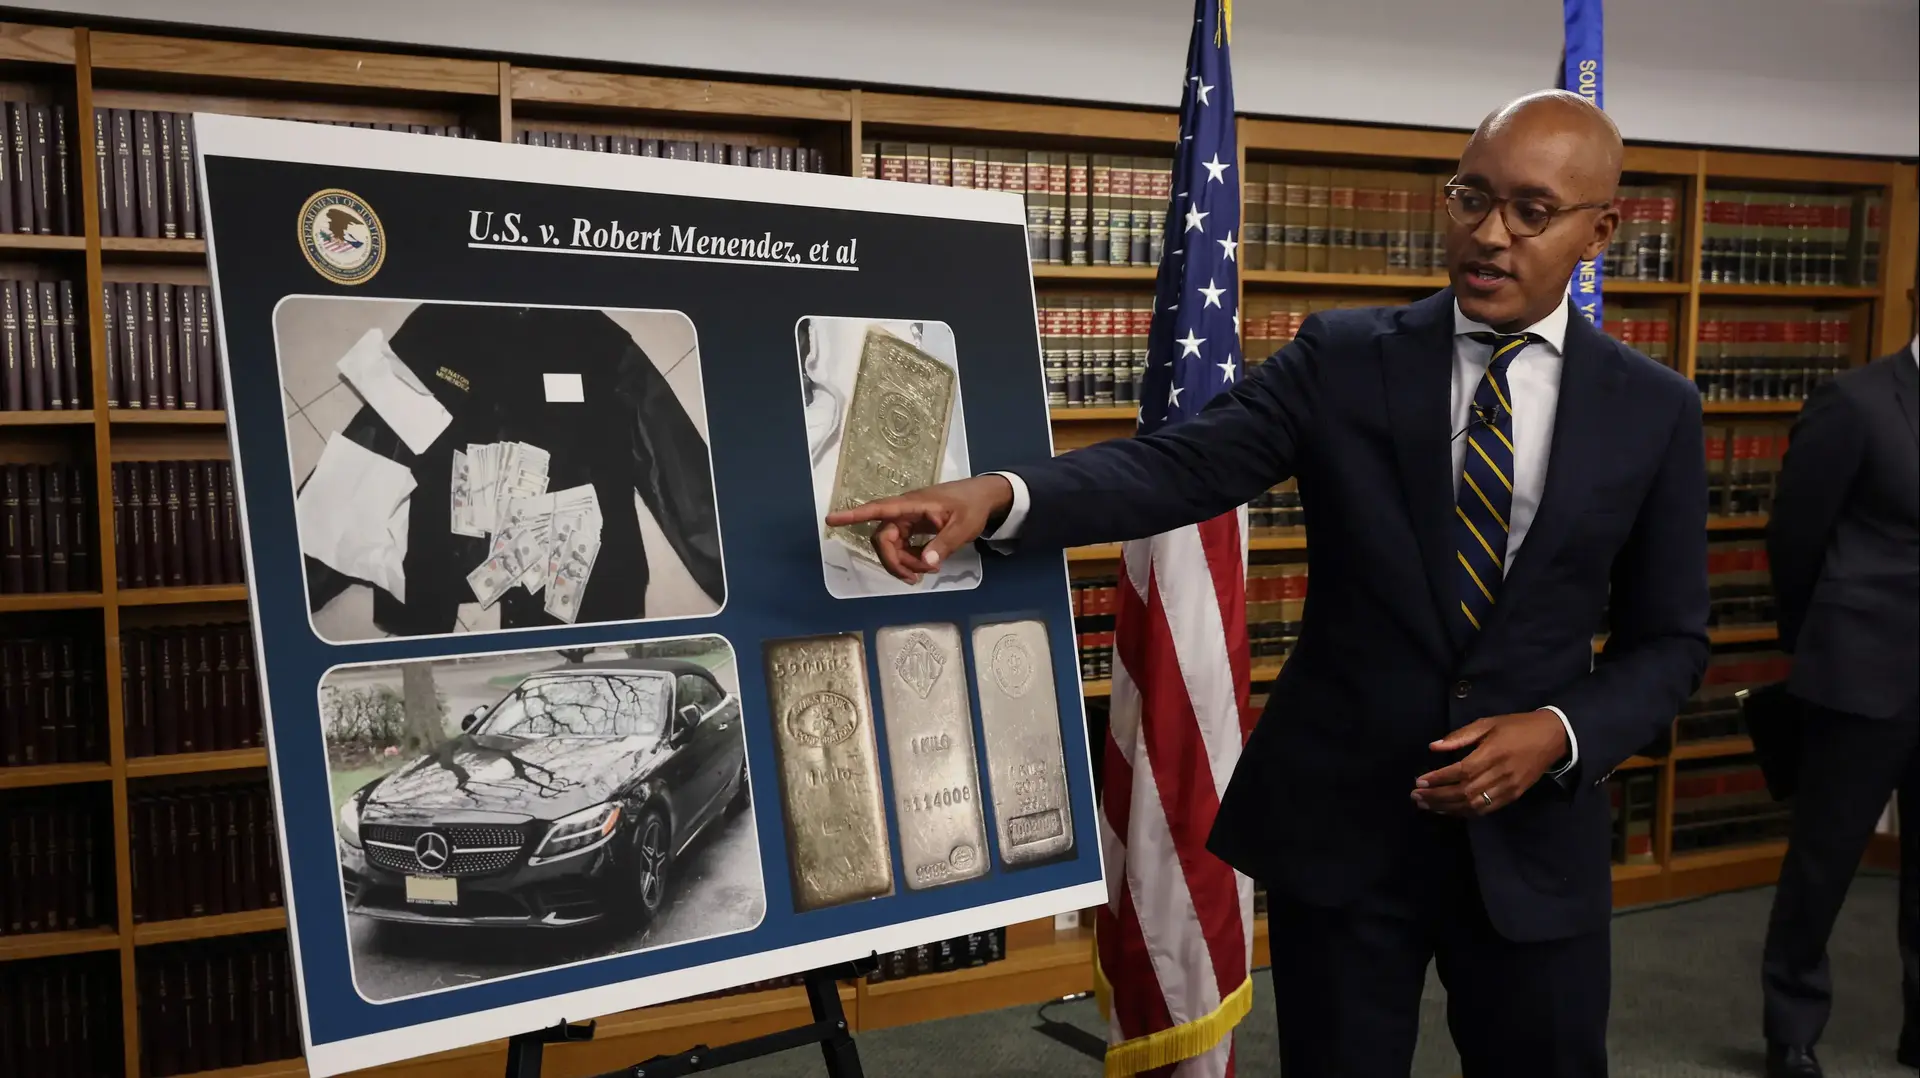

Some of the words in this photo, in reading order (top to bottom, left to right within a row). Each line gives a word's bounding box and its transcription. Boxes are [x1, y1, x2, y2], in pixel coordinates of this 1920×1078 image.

[304, 196, 341, 246] DEPARTMENT
[343, 198, 356, 208] OF
[357, 207, 380, 250] JUSTICE
[468, 209, 529, 243] U.S.
[538, 222, 560, 246] v.
[569, 217, 662, 252] Robert
[669, 224, 801, 265] Menendez,
[809, 239, 830, 262] et
[835, 238, 857, 265] al
[1579, 260, 1596, 293] NEW
